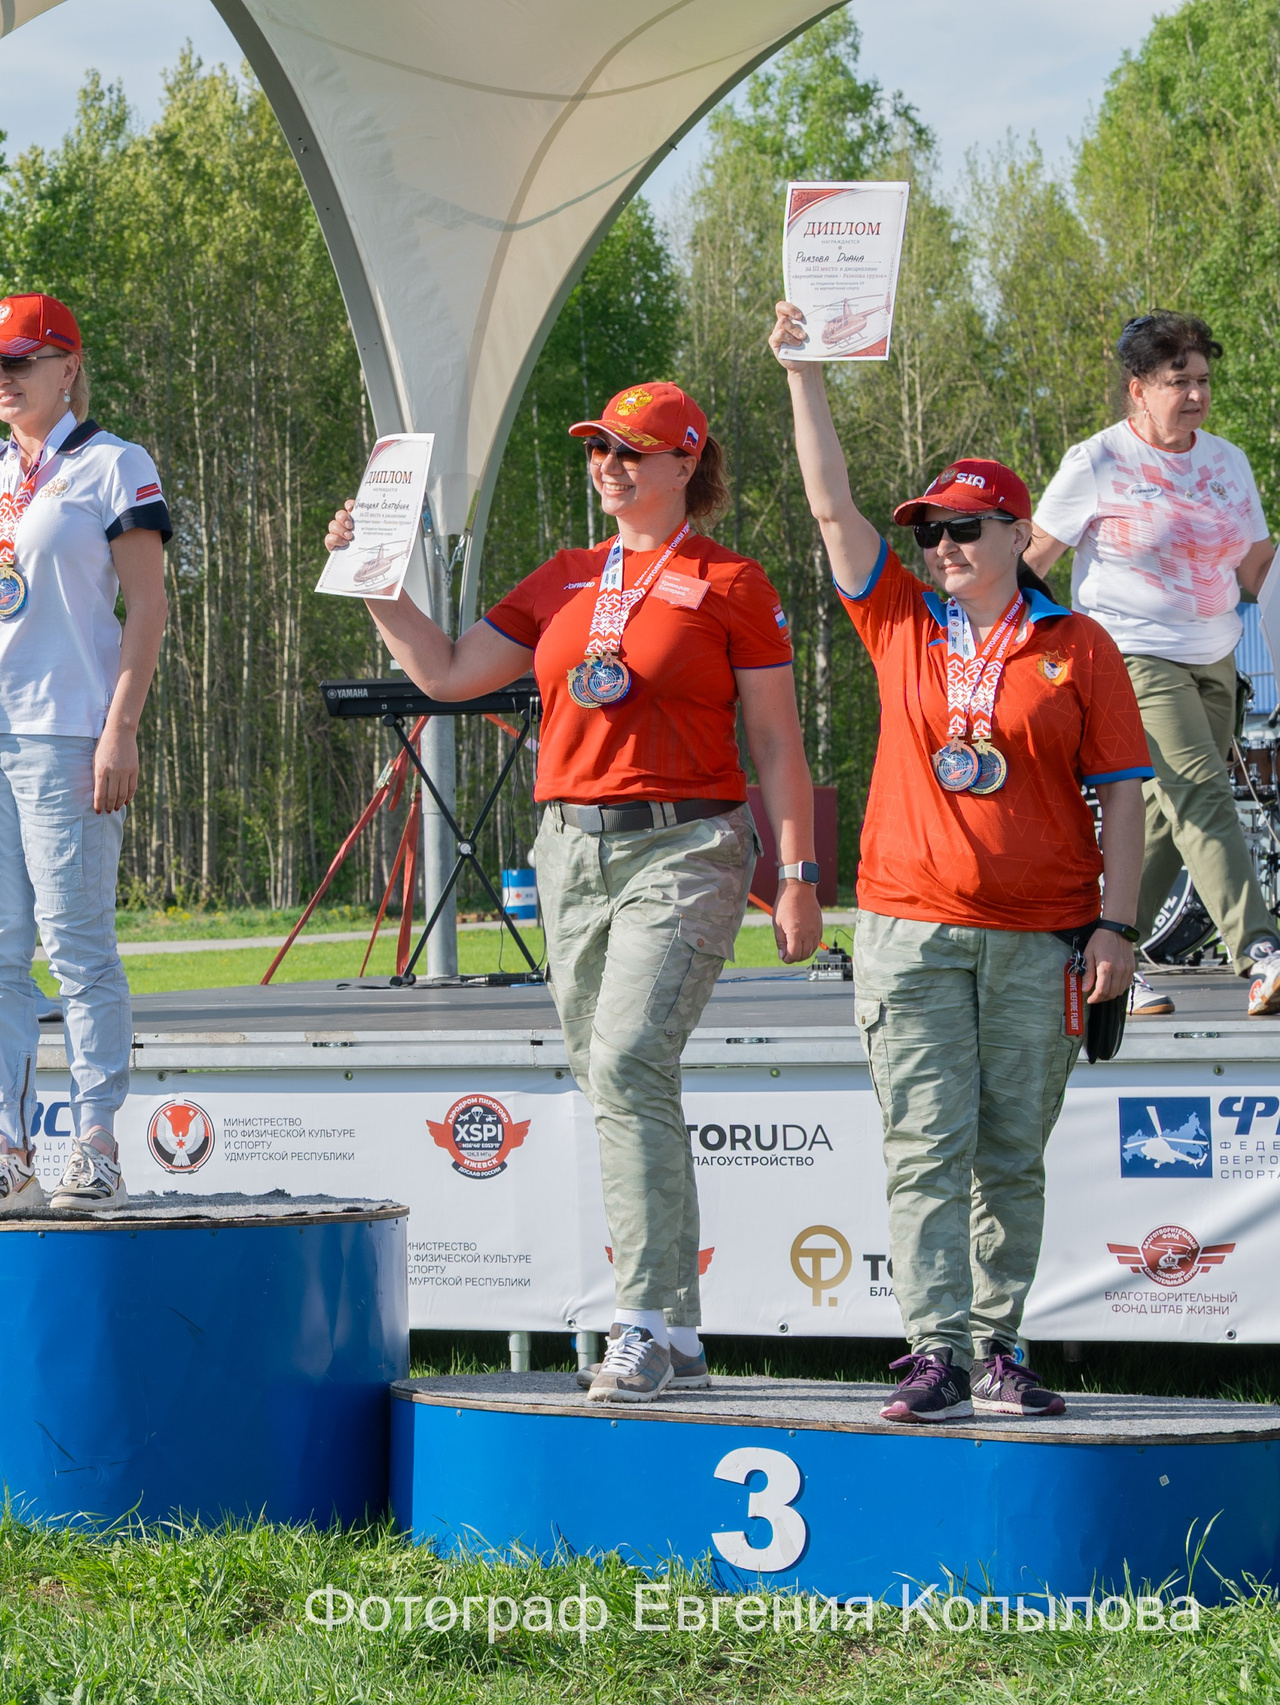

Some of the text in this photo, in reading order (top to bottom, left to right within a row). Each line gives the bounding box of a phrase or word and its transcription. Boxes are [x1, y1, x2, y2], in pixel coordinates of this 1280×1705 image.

[803, 221, 881, 238] ДИПЛОМ
[836, 252, 865, 263] Диана
[365, 471, 413, 487] ДИПЛОМ
[954, 472, 986, 489] SIA
[642, 547, 673, 586] ВЕРТОЛЕТНЫЕ
[669, 533, 685, 554] ГОНКИ
[981, 622, 1009, 657] ВЕРТОЛЕТНЫЕ
[1004, 602, 1020, 624] ГОНКИ
[337, 688, 368, 698] YAMAHA
[1070, 973, 1078, 991] EMOVE
[447, 1097, 509, 1124] АЭРОДРОМ ПИРОГОВО
[223, 1117, 302, 1127] МИНИСТРЕСТВО
[224, 1128, 356, 1139] ПО ФИЗИЧЕСКОЙ КУЛЬТУРЕ
[455, 1123, 503, 1142] XSPI
[685, 1124, 834, 1151] TORUDA
[224, 1141, 272, 1150] И СПОРТУ
[224, 1151, 355, 1162] УДМУРТСКОЙ РЕСПУБЛИКИ
[693, 1155, 814, 1166] ЛАГОУСТРОЙСТВО
[463, 1158, 498, 1169] ИЖЕВСК
[481, 1166, 502, 1177] РОССИИ
[1142, 1227, 1198, 1250] БЛАГОТВОРИТЕЛЬНЫЙ
[411, 1253, 480, 1263] ФИЗИЧЕСКОЙ
[483, 1254, 532, 1264] КУЛЬТУРЕ
[407, 1265, 447, 1275] СПОРТУ
[409, 1276, 531, 1287] МУРТСКОЙ РЕСПУБЛИКИ
[1105, 1291, 1238, 1303] БЛАГОТВОРИТЕЛЬНЫЙ
[1111, 1304, 1229, 1315] ФОНД ШТАБ ЖИЗНИ
[712, 1447, 807, 1572] 3
